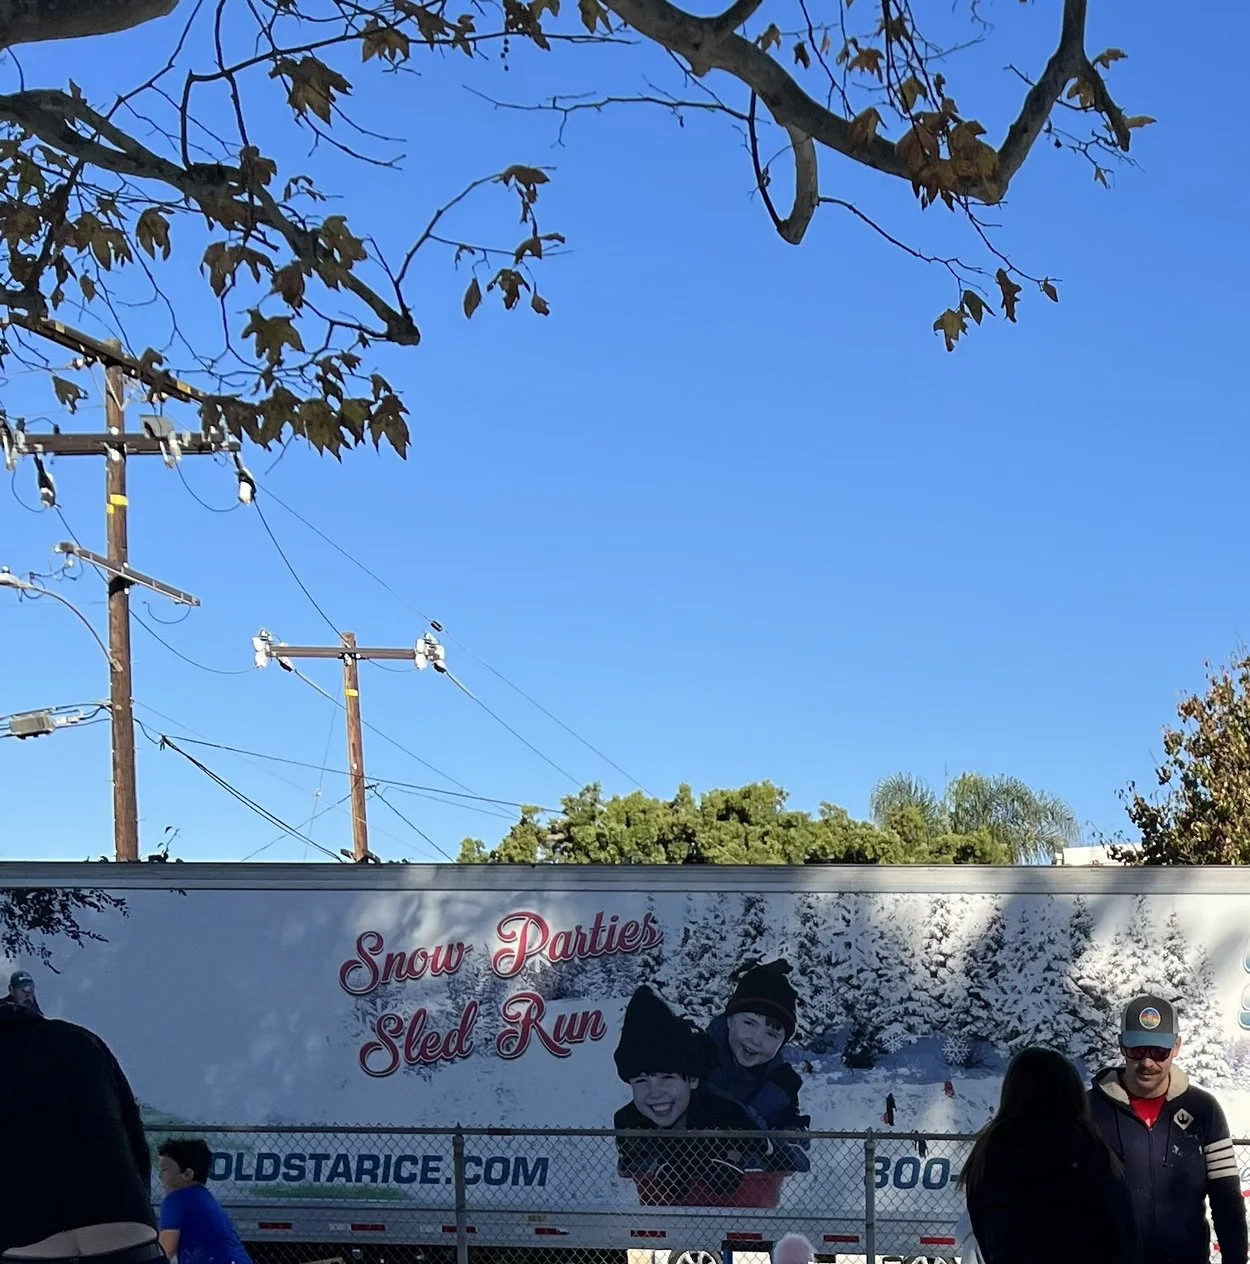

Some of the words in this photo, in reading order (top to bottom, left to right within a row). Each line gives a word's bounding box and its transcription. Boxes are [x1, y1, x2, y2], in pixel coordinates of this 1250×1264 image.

[339, 930, 472, 995] Snow
[491, 911, 665, 978] Parties
[359, 1000, 478, 1077] Sled
[496, 991, 608, 1058] Run
[208, 1151, 550, 1187] OLDSTARICE.COM
